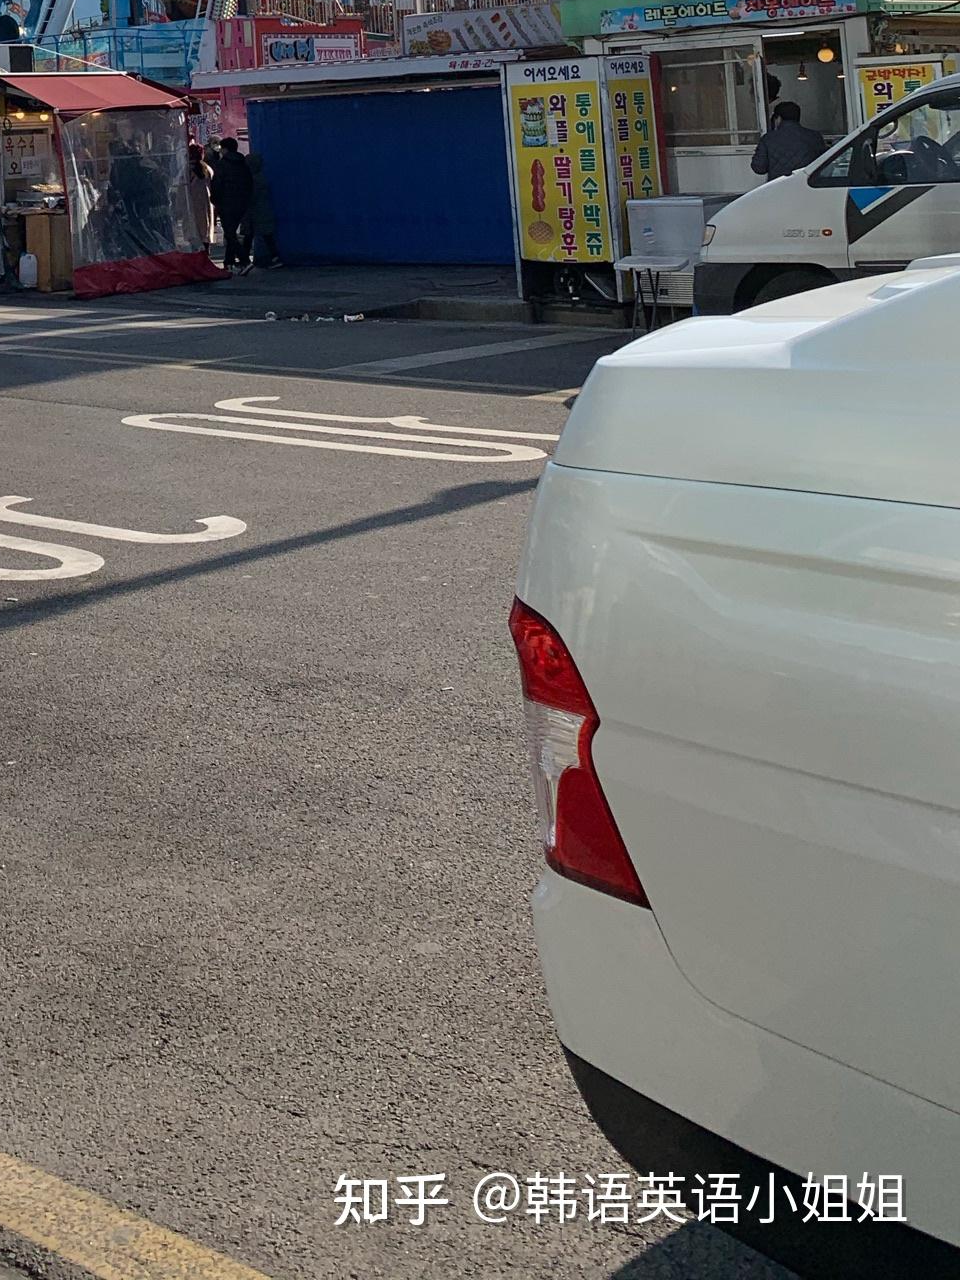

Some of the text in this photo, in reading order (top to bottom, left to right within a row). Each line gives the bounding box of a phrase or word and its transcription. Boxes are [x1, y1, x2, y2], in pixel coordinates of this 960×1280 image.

[644, 1, 728, 25] 레몬에이드
[523, 65, 581, 82] 어서오세요
[610, 61, 645, 75] 어서오세요
[548, 94, 578, 261] 와플·딸기탕후
